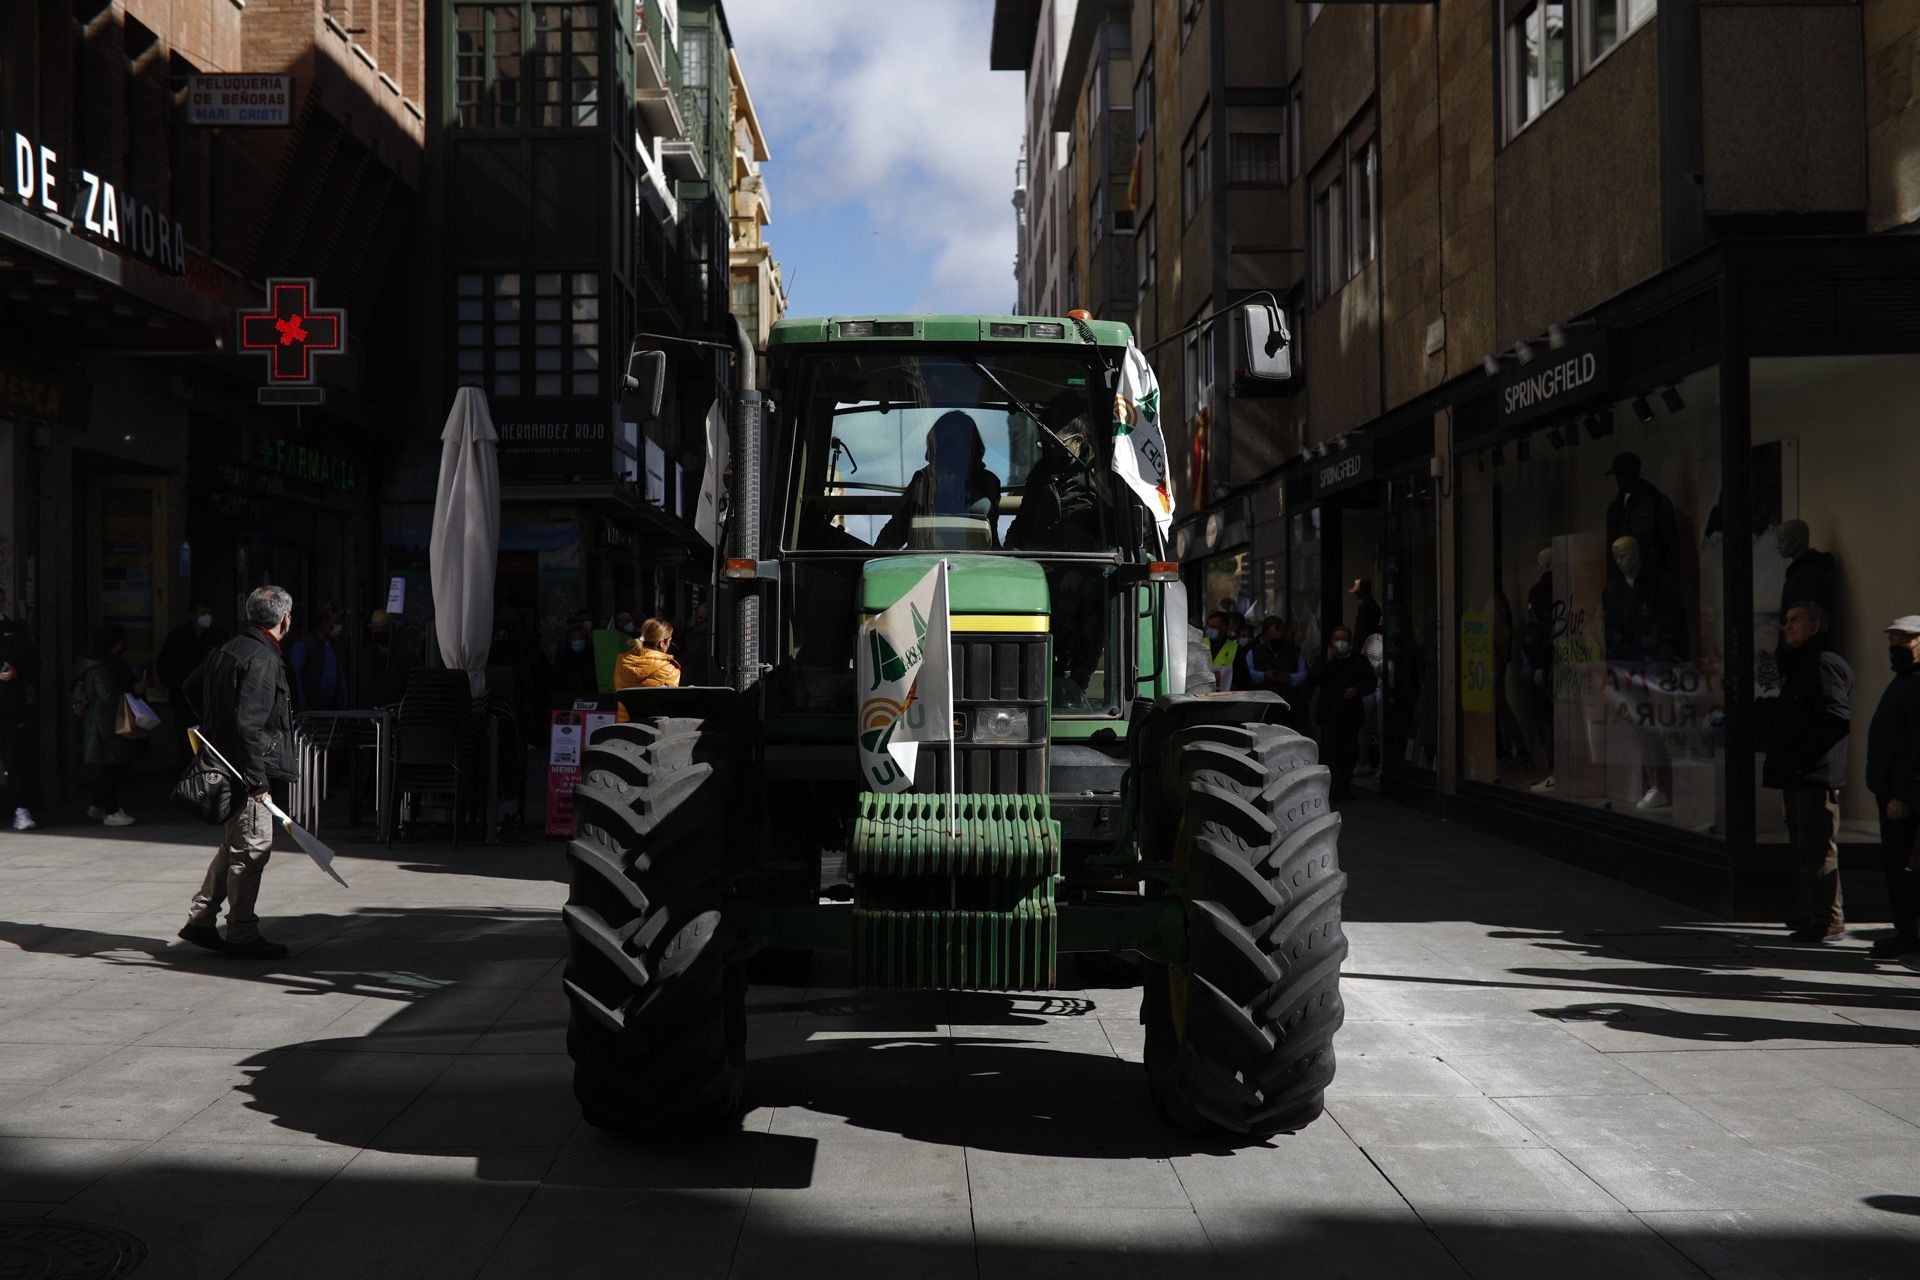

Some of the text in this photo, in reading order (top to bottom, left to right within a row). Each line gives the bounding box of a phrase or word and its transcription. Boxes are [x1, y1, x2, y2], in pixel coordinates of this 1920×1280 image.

[196, 78, 282, 90] PELUQUERIA
[193, 91, 285, 105] DE SEÑORAS
[196, 108, 282, 120] MARI CRISTI
[15, 130, 58, 213] DE
[82, 168, 186, 276] ZAMORA
[1505, 352, 1596, 414] SPRINGFIELD
[501, 423, 605, 440] HERNANDEZ ROJO
[275, 438, 358, 491] FARMACIA
[1320, 455, 1361, 488] SPRINGFIELD
